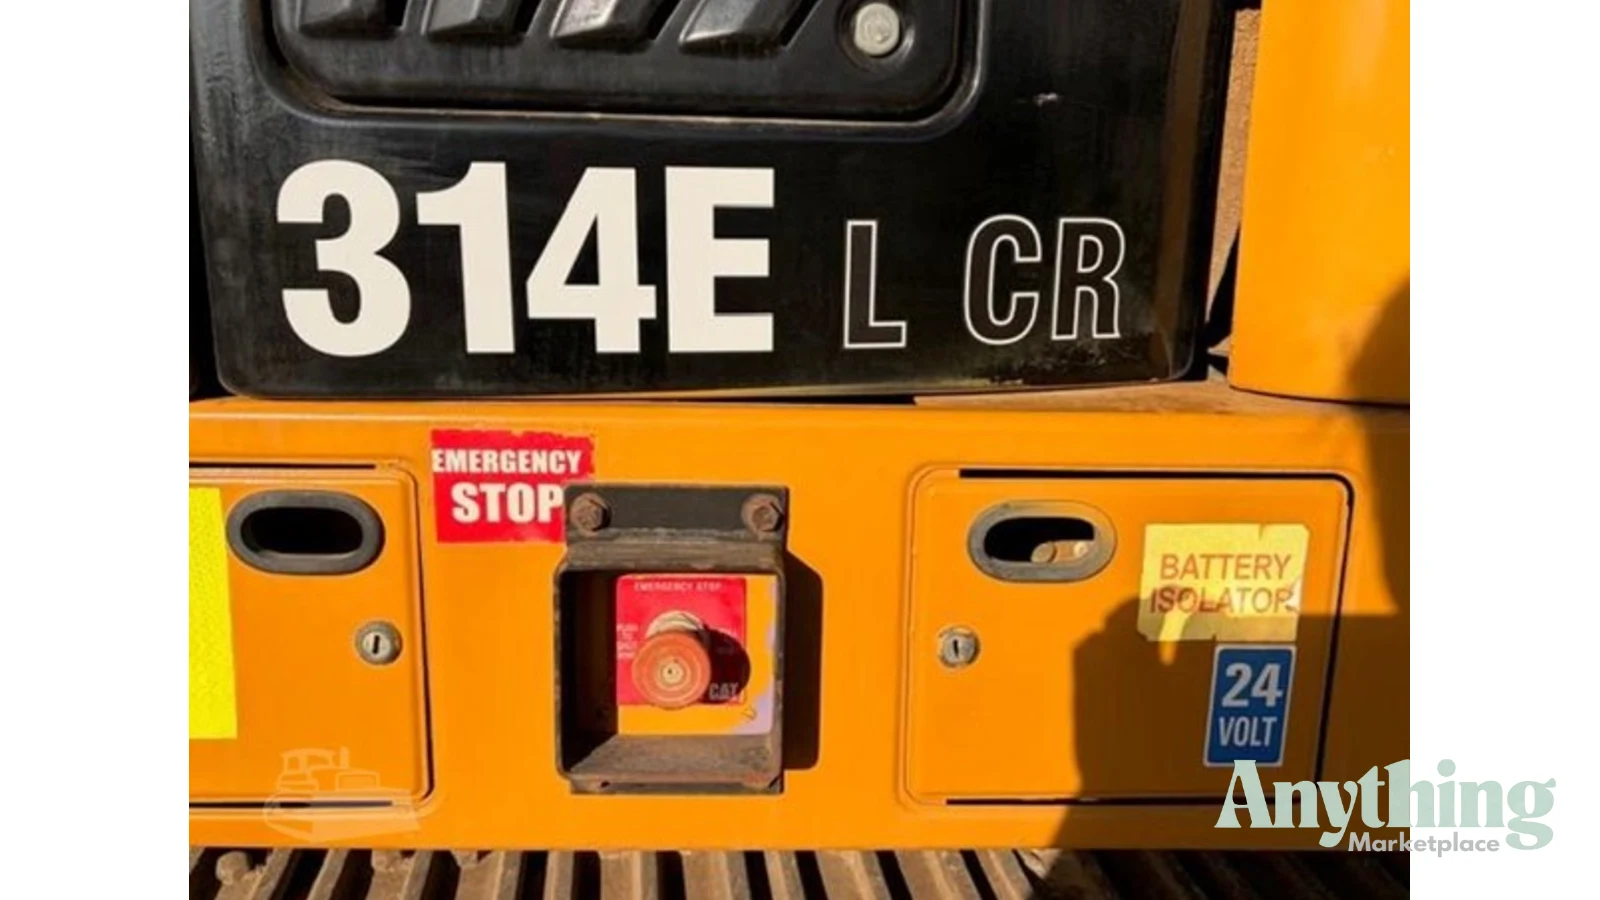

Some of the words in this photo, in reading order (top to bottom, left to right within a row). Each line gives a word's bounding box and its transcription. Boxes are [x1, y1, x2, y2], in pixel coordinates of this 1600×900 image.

[277, 160, 774, 356] 314E
[843, 219, 907, 349] L
[962, 214, 1126, 345] CR
[431, 449, 581, 473] EMERGENCY
[452, 482, 563, 523] STOP
[1160, 554, 1291, 580] BATTERY
[709, 682, 739, 699] CAT
[1221, 663, 1283, 708] 24
[1219, 716, 1277, 747] VOLT
